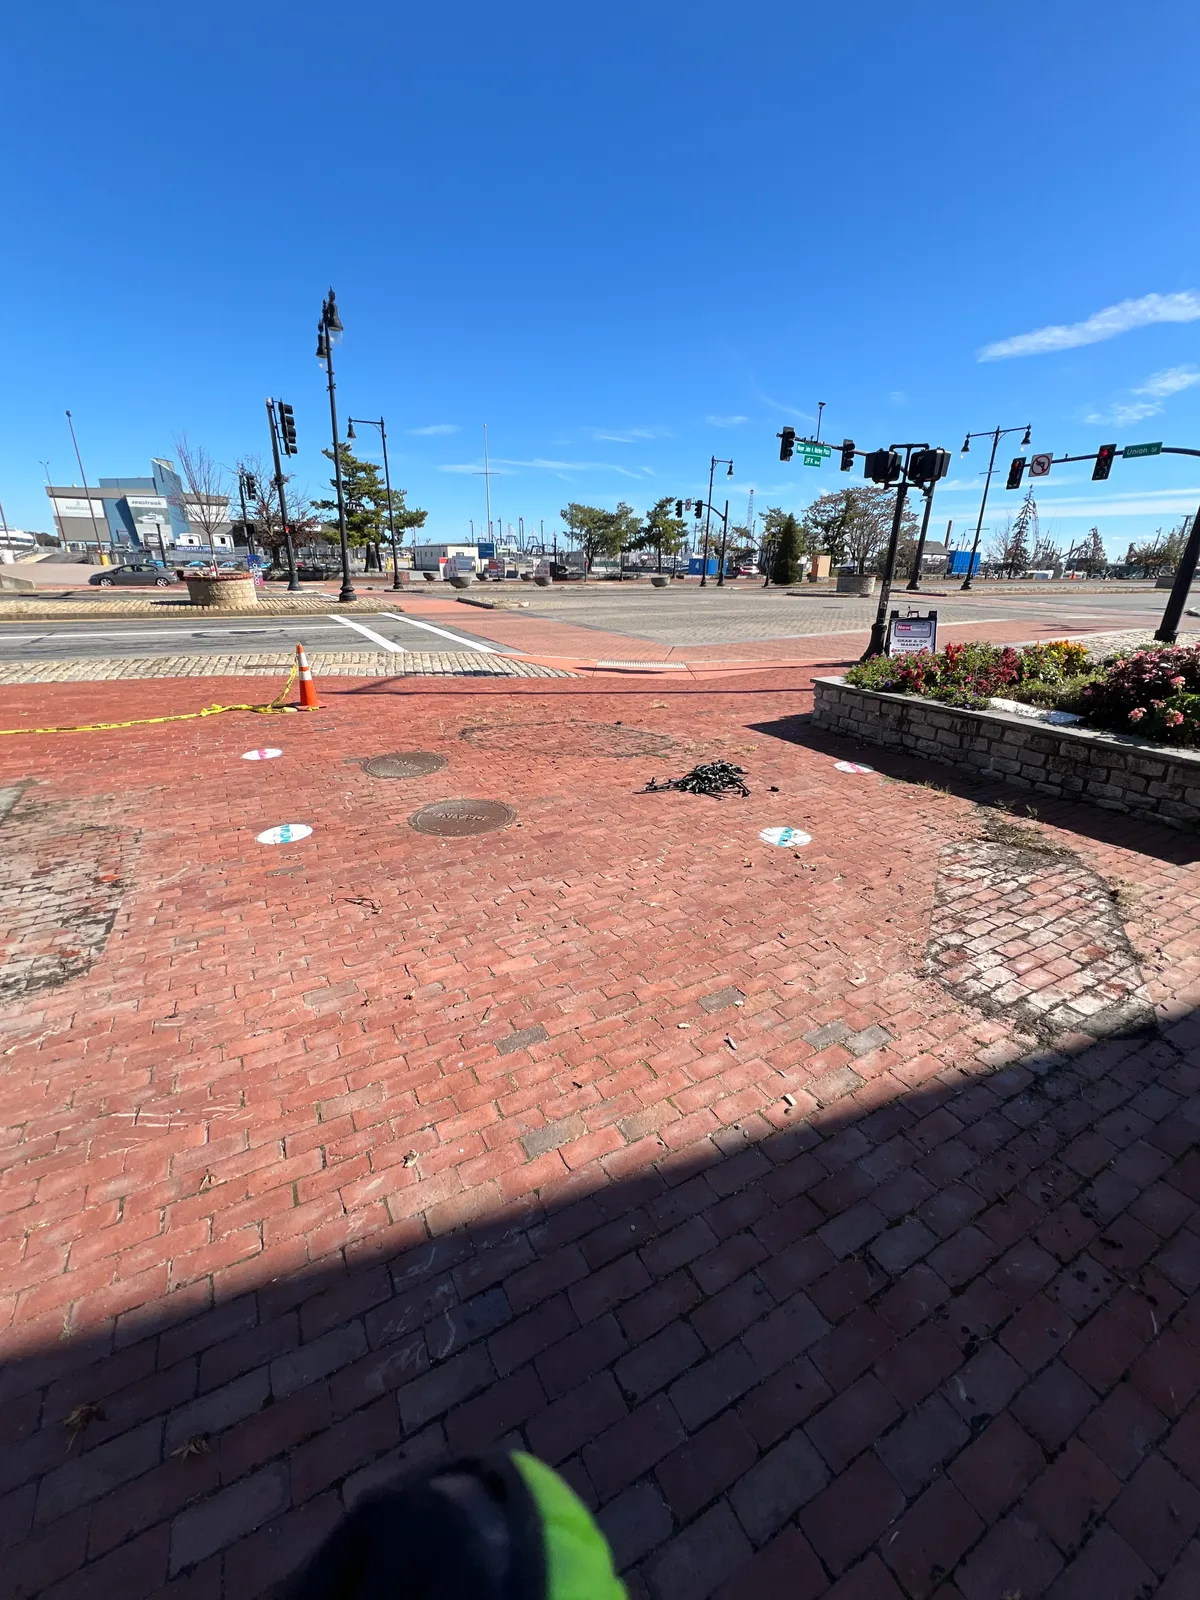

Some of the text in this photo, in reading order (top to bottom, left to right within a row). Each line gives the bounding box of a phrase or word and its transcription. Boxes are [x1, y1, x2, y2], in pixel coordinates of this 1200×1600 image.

[1126, 447, 1148, 456] Union
[805, 457, 814, 465] JFK
[695, 561, 700, 569] 4
